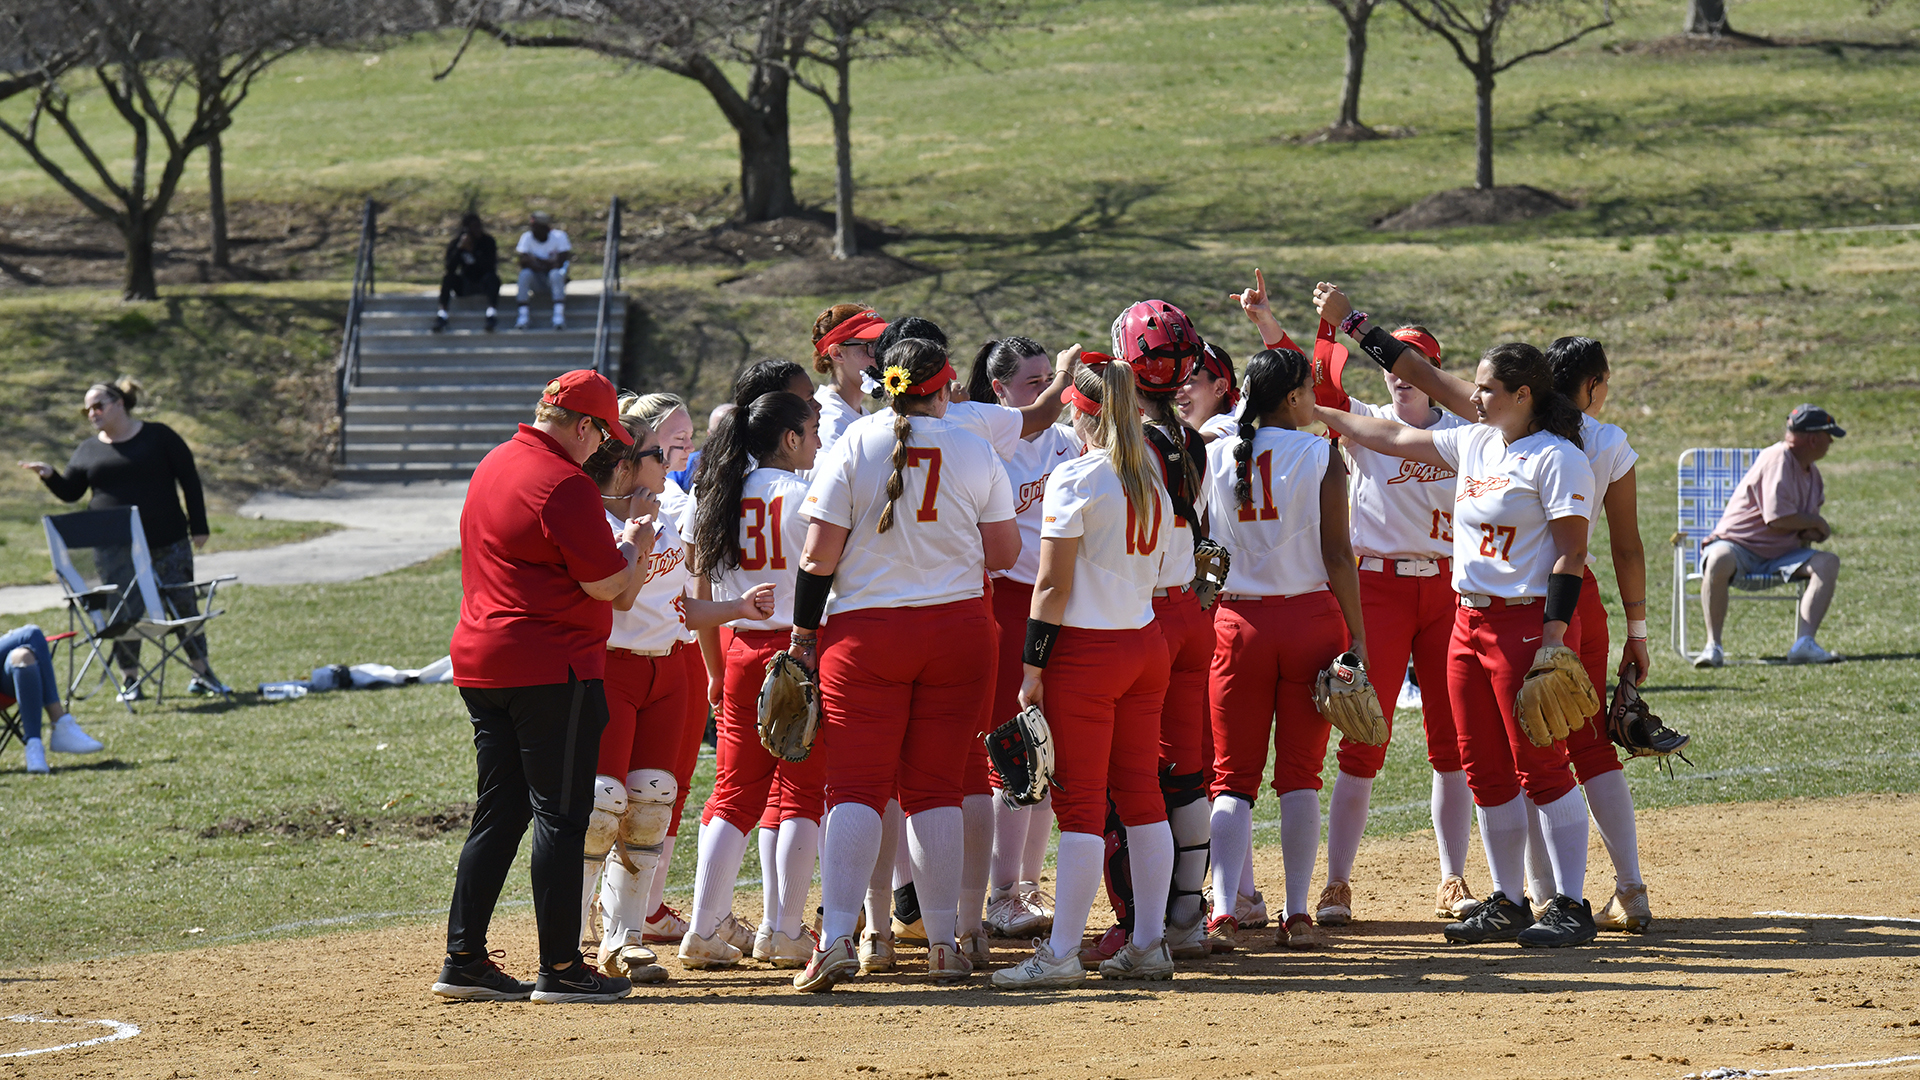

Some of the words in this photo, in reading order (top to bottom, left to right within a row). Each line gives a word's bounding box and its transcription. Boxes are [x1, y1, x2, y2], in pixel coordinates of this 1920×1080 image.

[906, 446, 943, 523] 7
[739, 495, 787, 571] 31
[1480, 522, 1517, 562] 27
